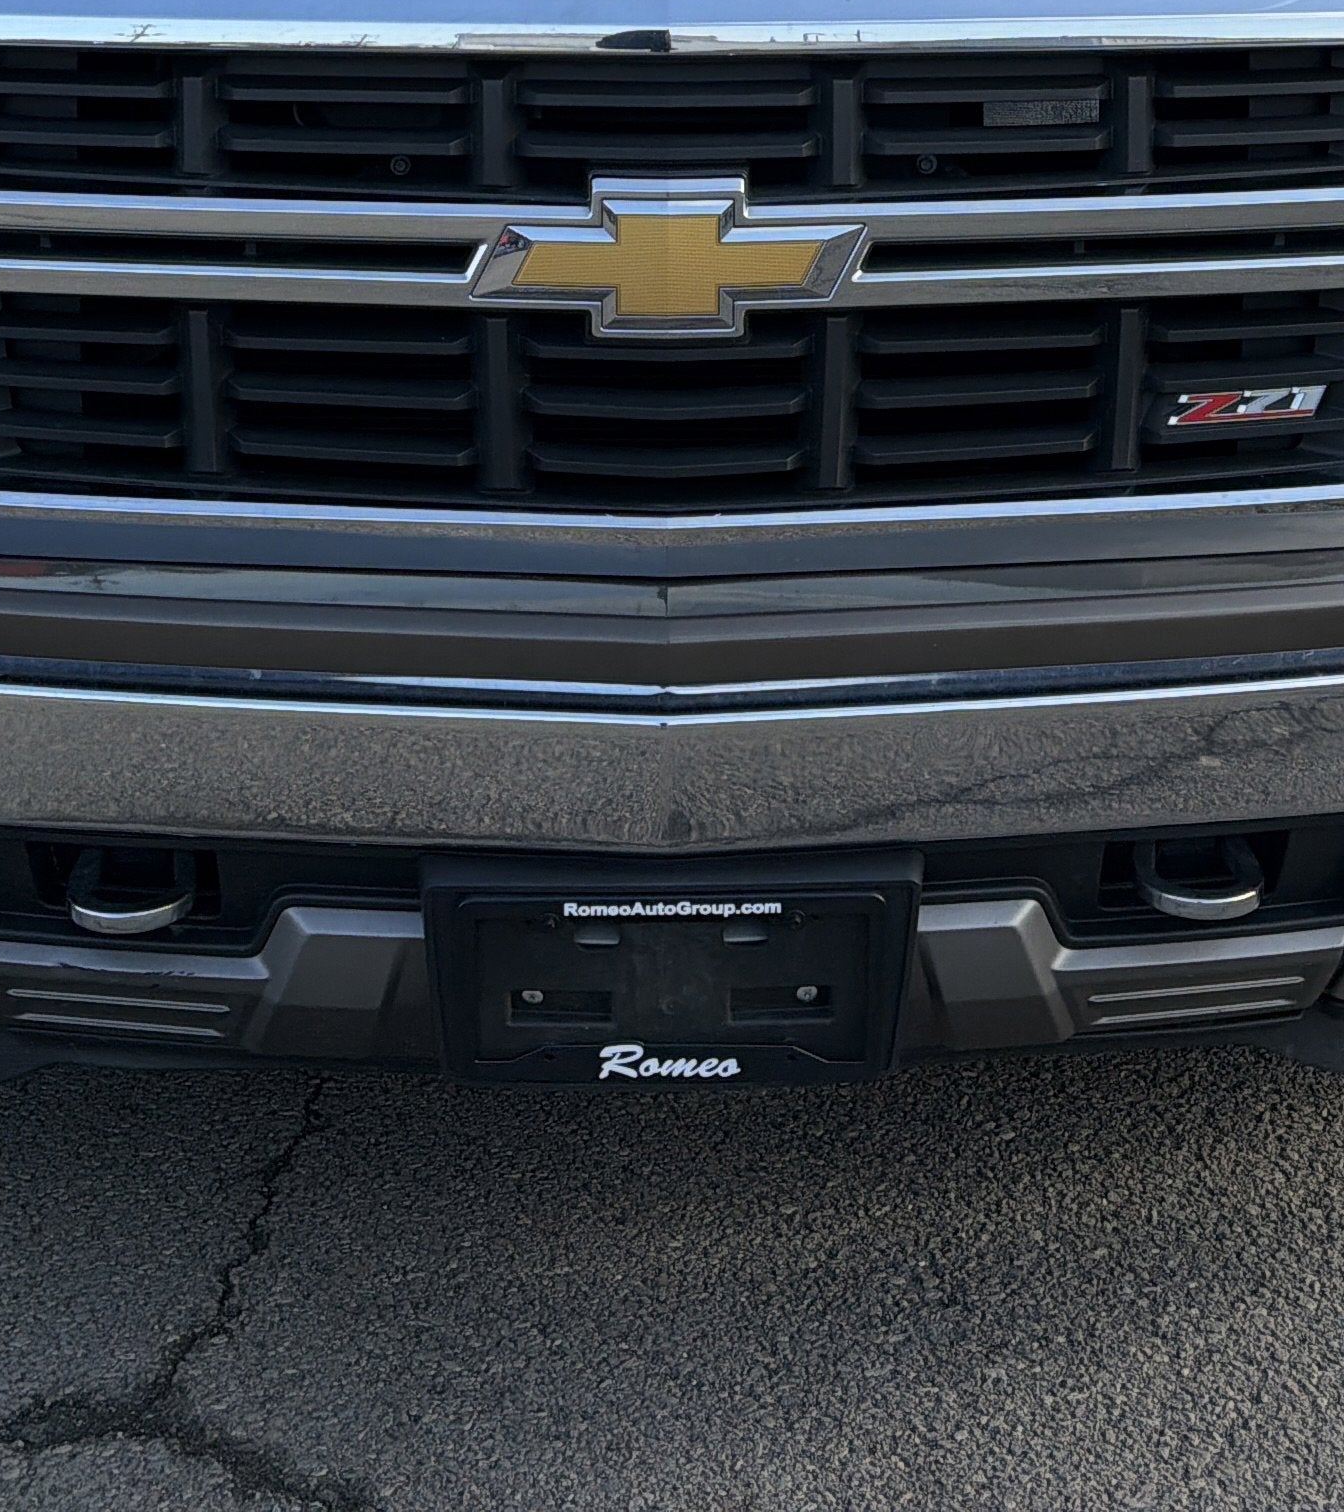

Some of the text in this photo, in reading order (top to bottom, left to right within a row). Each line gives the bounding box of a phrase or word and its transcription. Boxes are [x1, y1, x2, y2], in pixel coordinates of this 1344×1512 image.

[1167, 385, 1327, 425] Z71
[563, 901, 782, 918] RomeoAutoGroup.com
[599, 1044, 742, 1080] Romeo
